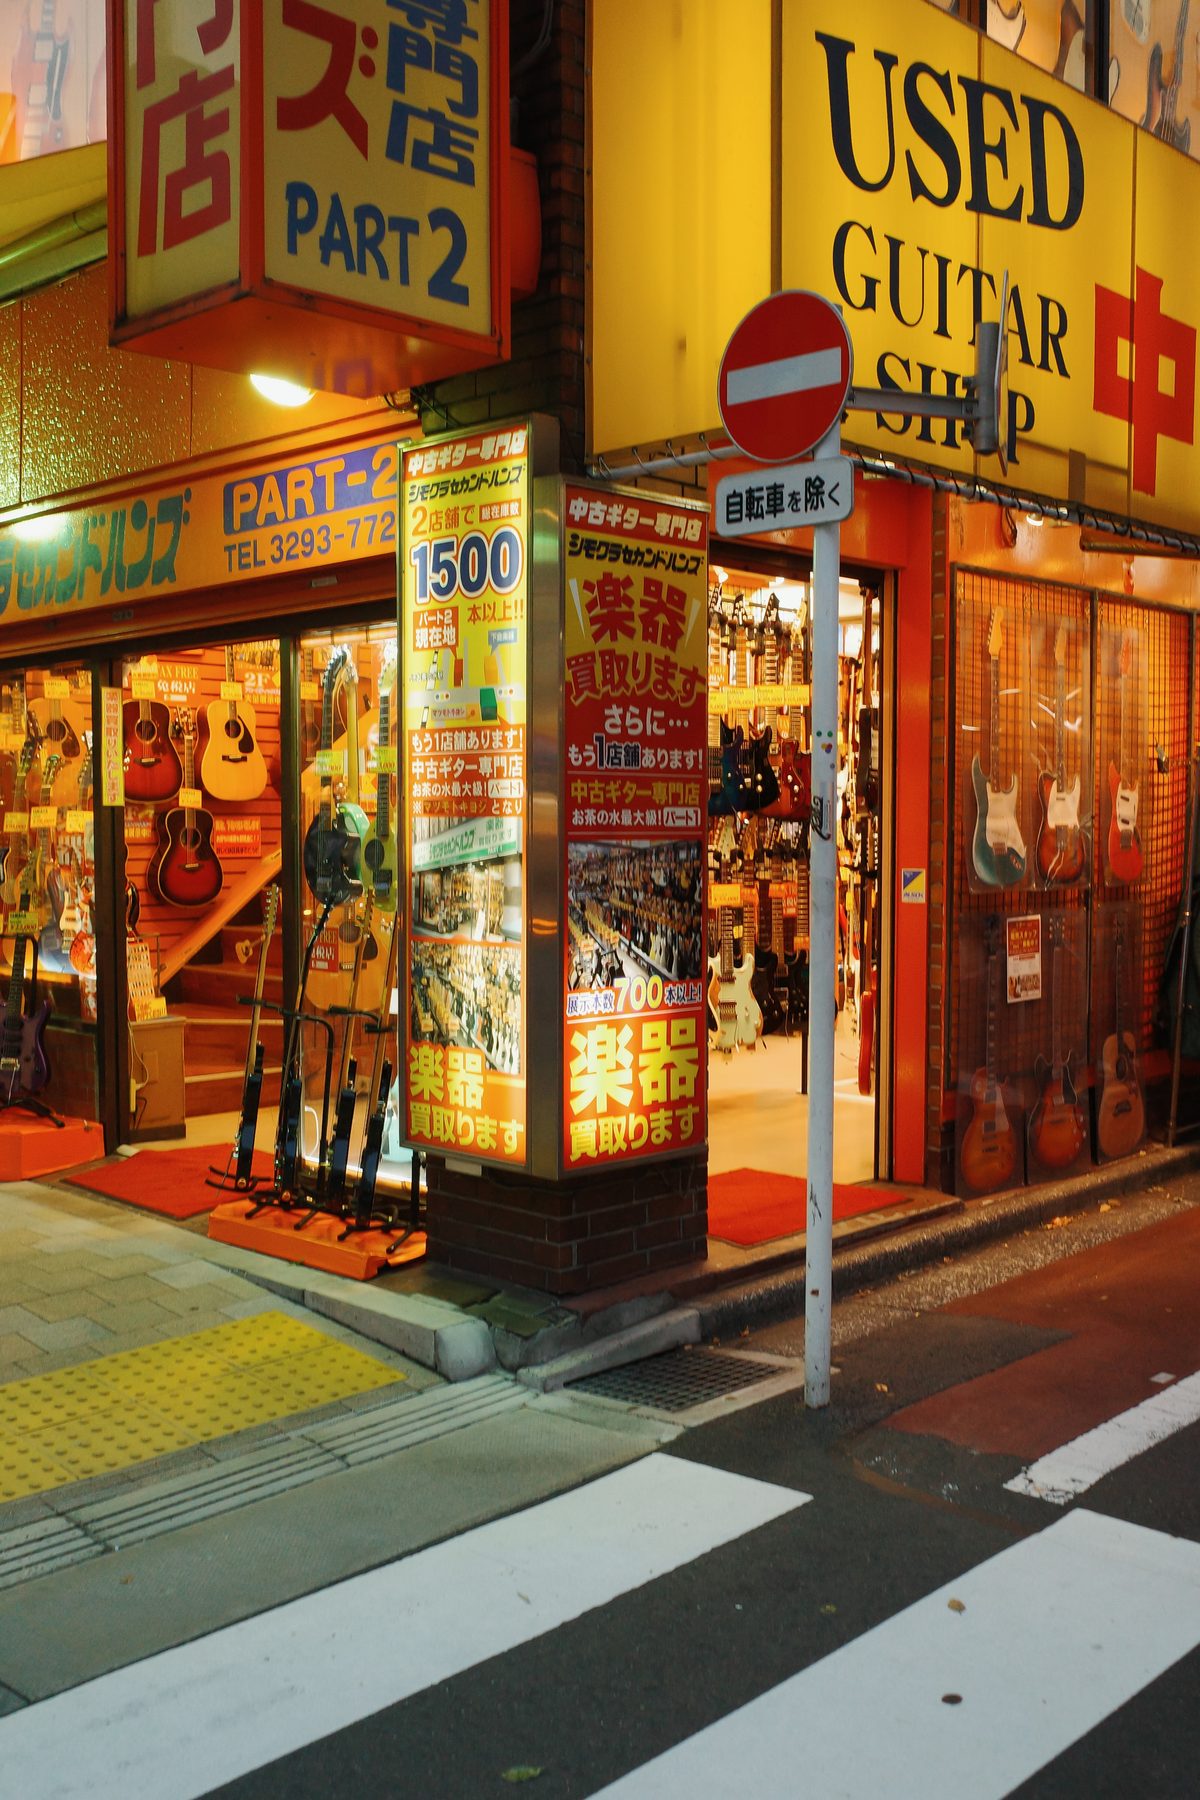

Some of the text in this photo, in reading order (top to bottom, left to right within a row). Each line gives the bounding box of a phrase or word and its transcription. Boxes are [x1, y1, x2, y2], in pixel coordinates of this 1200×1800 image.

[815, 31, 1085, 231] USED
[832, 220, 1071, 379] GUITAR
[1093, 264, 1198, 497] 中
[875, 352, 1035, 465] SHP
[407, 430, 527, 476] 中古ギター専門店
[233, 444, 397, 531] PART-2
[408, 463, 527, 503] シモクラセカンドハンズ
[725, 477, 842, 525] 自転車を除く
[411, 504, 475, 537] 2店舗で
[569, 497, 702, 542] 中古ギター専門店
[224, 543, 265, 572] TEL
[411, 527, 521, 602] 1500
[568, 533, 704, 576] シモクラセカンドハンズ
[419, 609, 453, 626] パート2
[582, 572, 688, 652] 楽器
[415, 625, 456, 648] 現在地
[158, 665, 173, 678] AX
[566, 649, 706, 707] 買取ります
[412, 728, 523, 752] もう1店舗あります!
[568, 733, 703, 770] もう1店舗あります!
[412, 755, 523, 780] 中古ギター専門店
[571, 779, 700, 805] 中古ギター専門店
[572, 808, 662, 827] お茶の水最大級!
[410, 1045, 484, 1110] 楽器
[569, 1018, 699, 1115] 楽器
[410, 1101, 523, 1154] 買取ります
[570, 1104, 700, 1162] 買取ります
